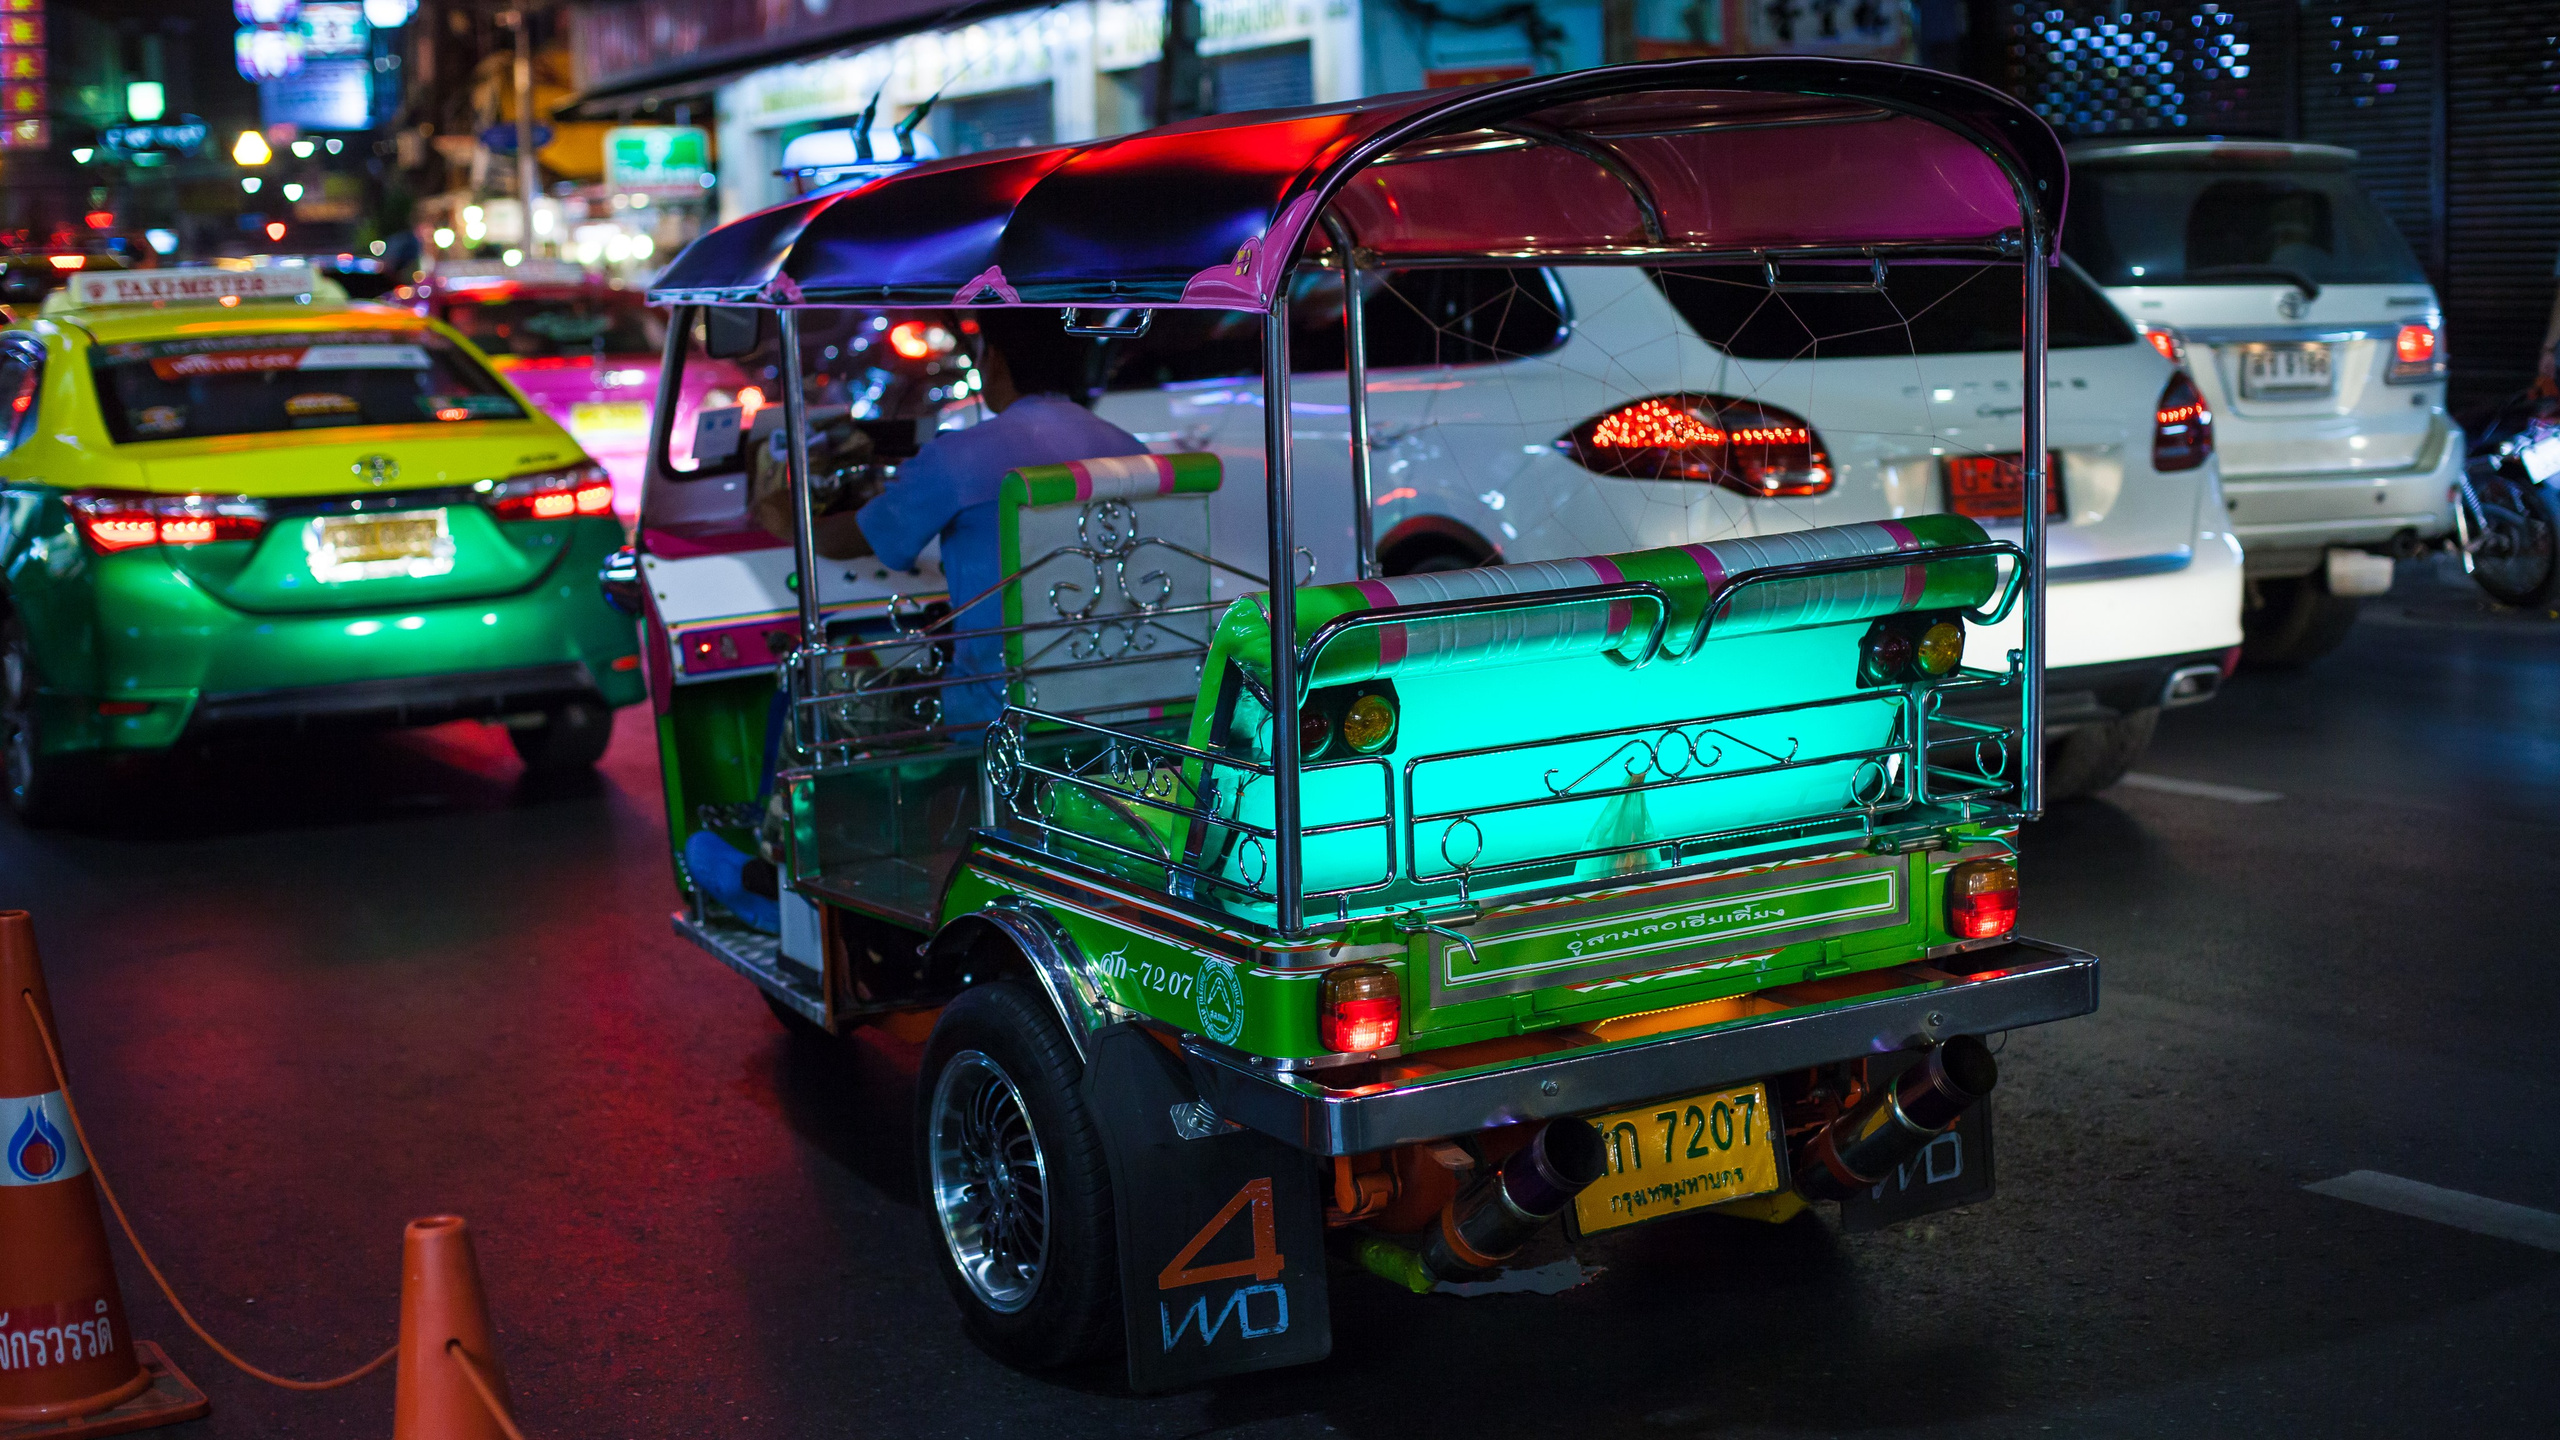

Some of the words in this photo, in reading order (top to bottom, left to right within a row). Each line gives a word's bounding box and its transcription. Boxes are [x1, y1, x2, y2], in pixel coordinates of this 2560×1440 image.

[1594, 1121, 1641, 1176] ก
[1656, 1093, 1755, 1163] 7207
[1610, 1168, 1744, 1216] กรุงเทพมหานคร
[1158, 1177, 1285, 1290] 4
[1160, 1283, 1289, 1354] WD
